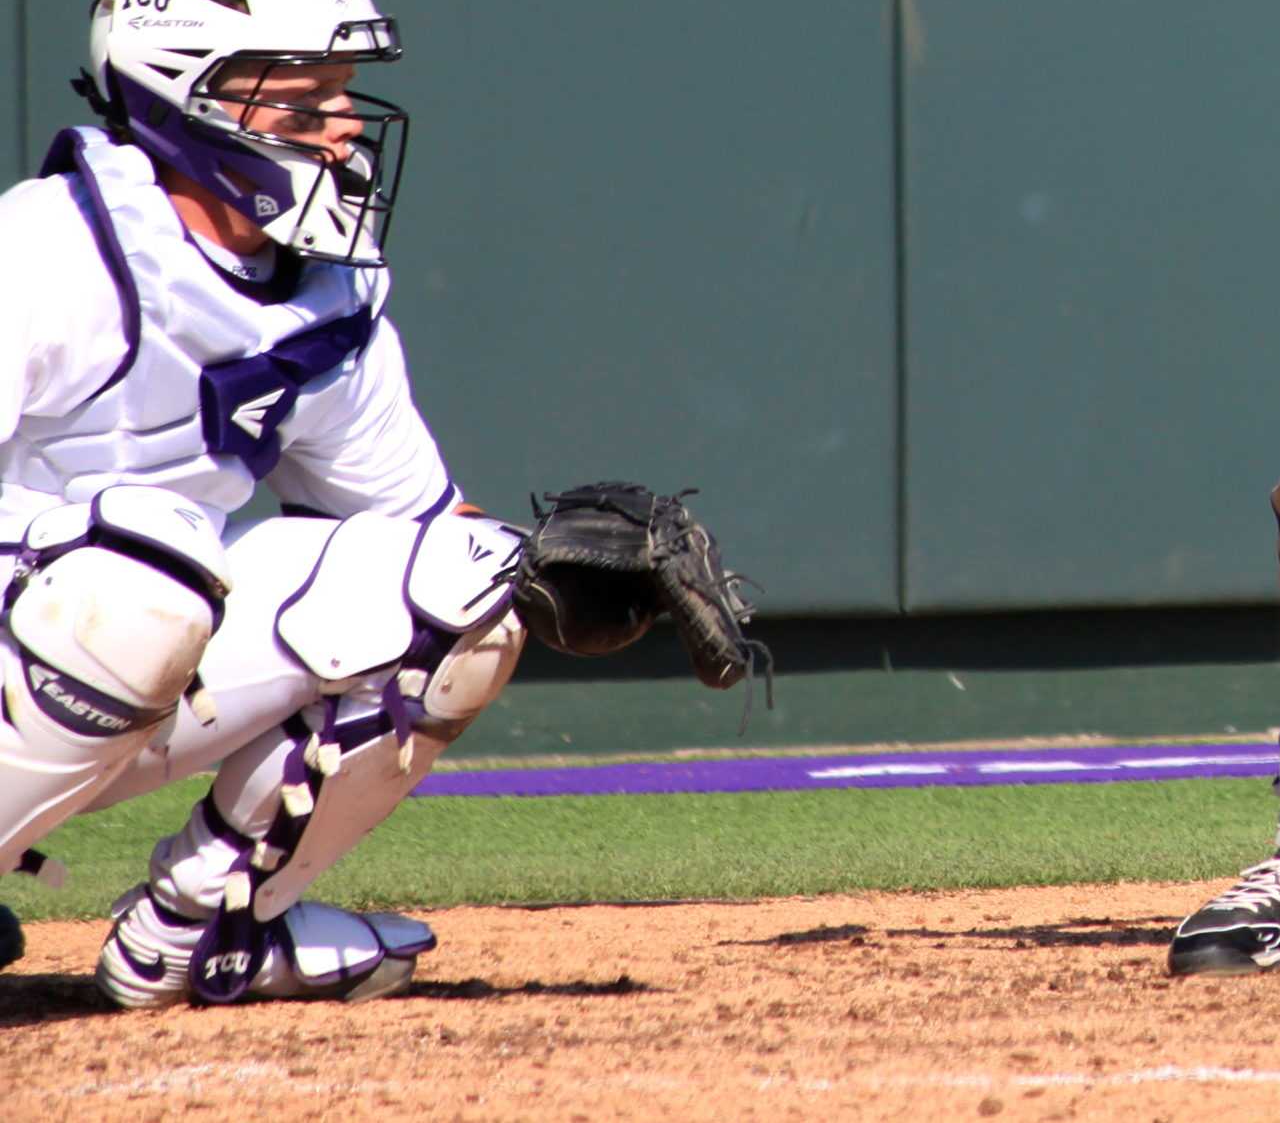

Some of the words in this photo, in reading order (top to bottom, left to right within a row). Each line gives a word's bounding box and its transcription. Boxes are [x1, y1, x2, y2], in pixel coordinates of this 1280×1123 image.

[142, 19, 205, 28] EASTON
[42, 681, 132, 730] EASTON
[205, 950, 252, 980] TCU
